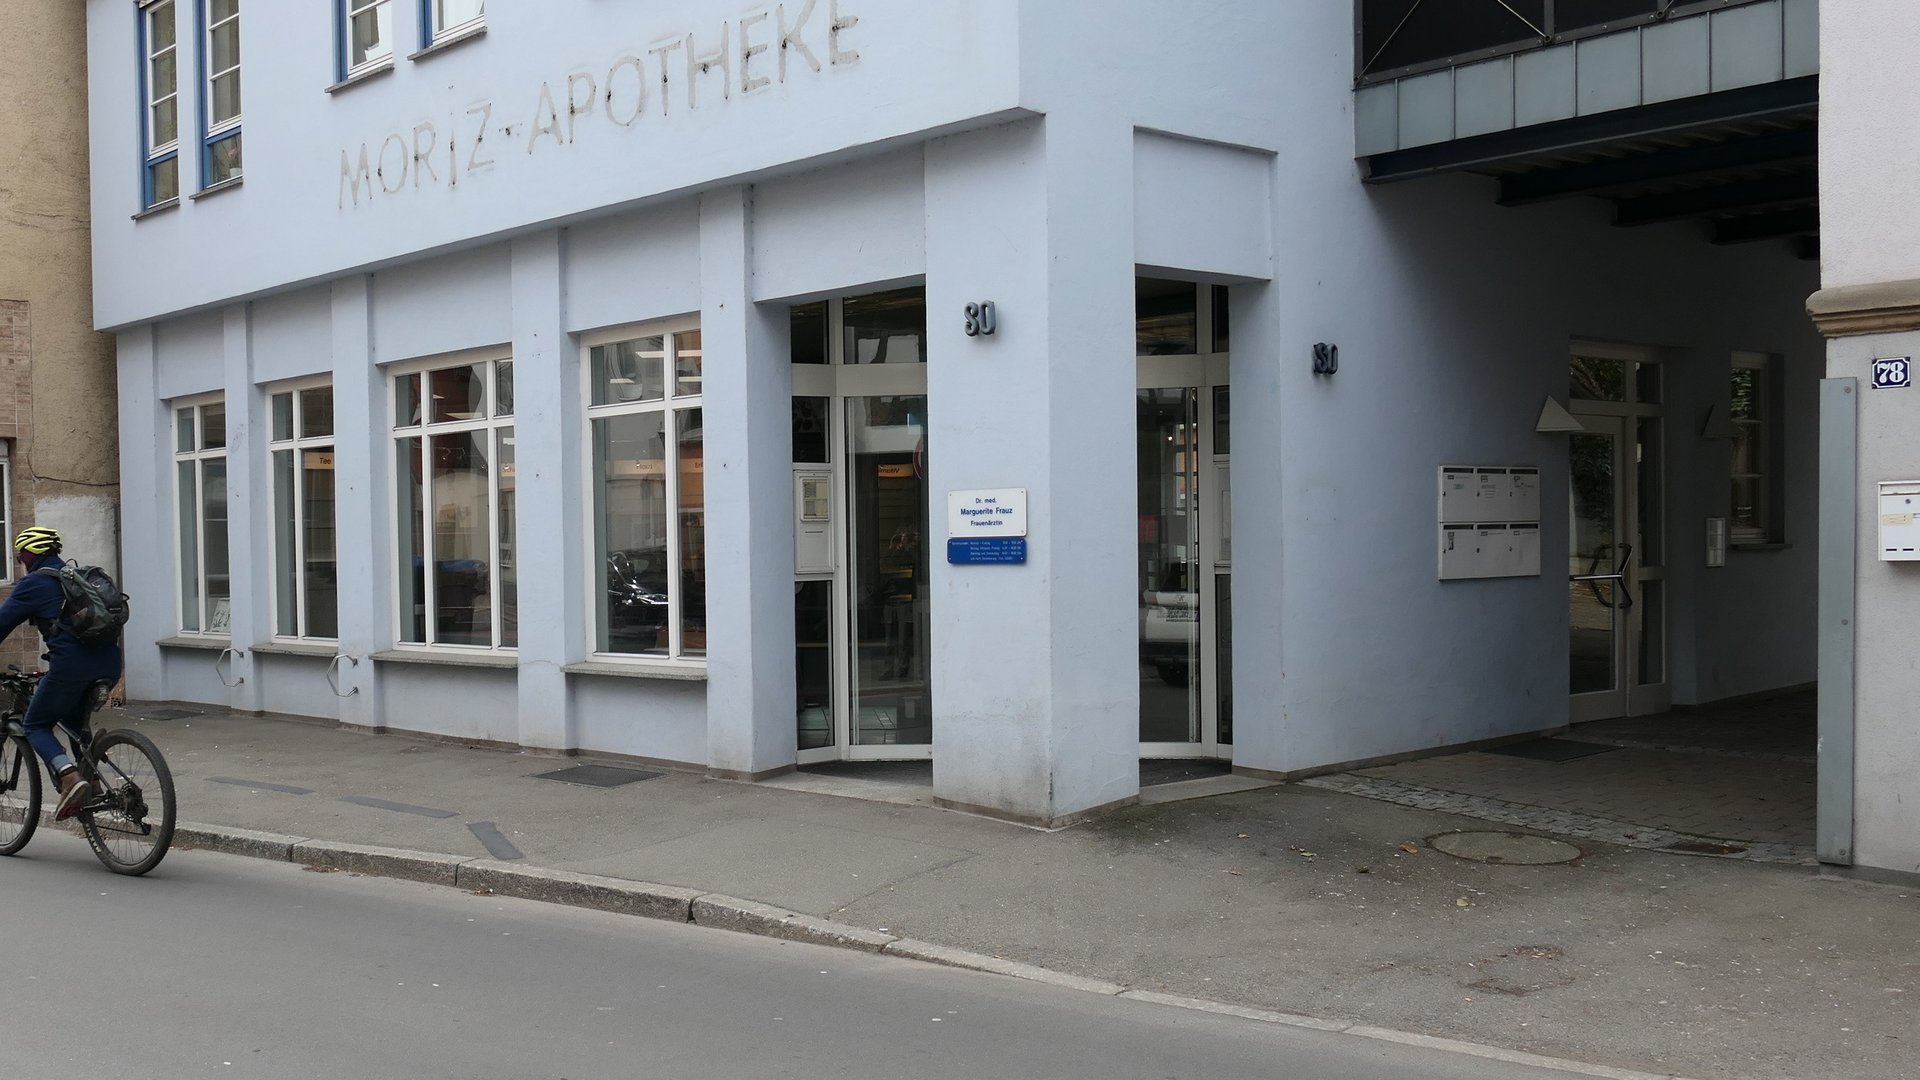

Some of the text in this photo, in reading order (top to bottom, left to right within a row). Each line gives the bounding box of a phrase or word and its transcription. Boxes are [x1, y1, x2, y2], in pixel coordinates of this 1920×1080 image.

[1877, 361, 1905, 384] 78
[319, 457, 332, 465] Tee
[960, 508, 993, 516] Marguerite
